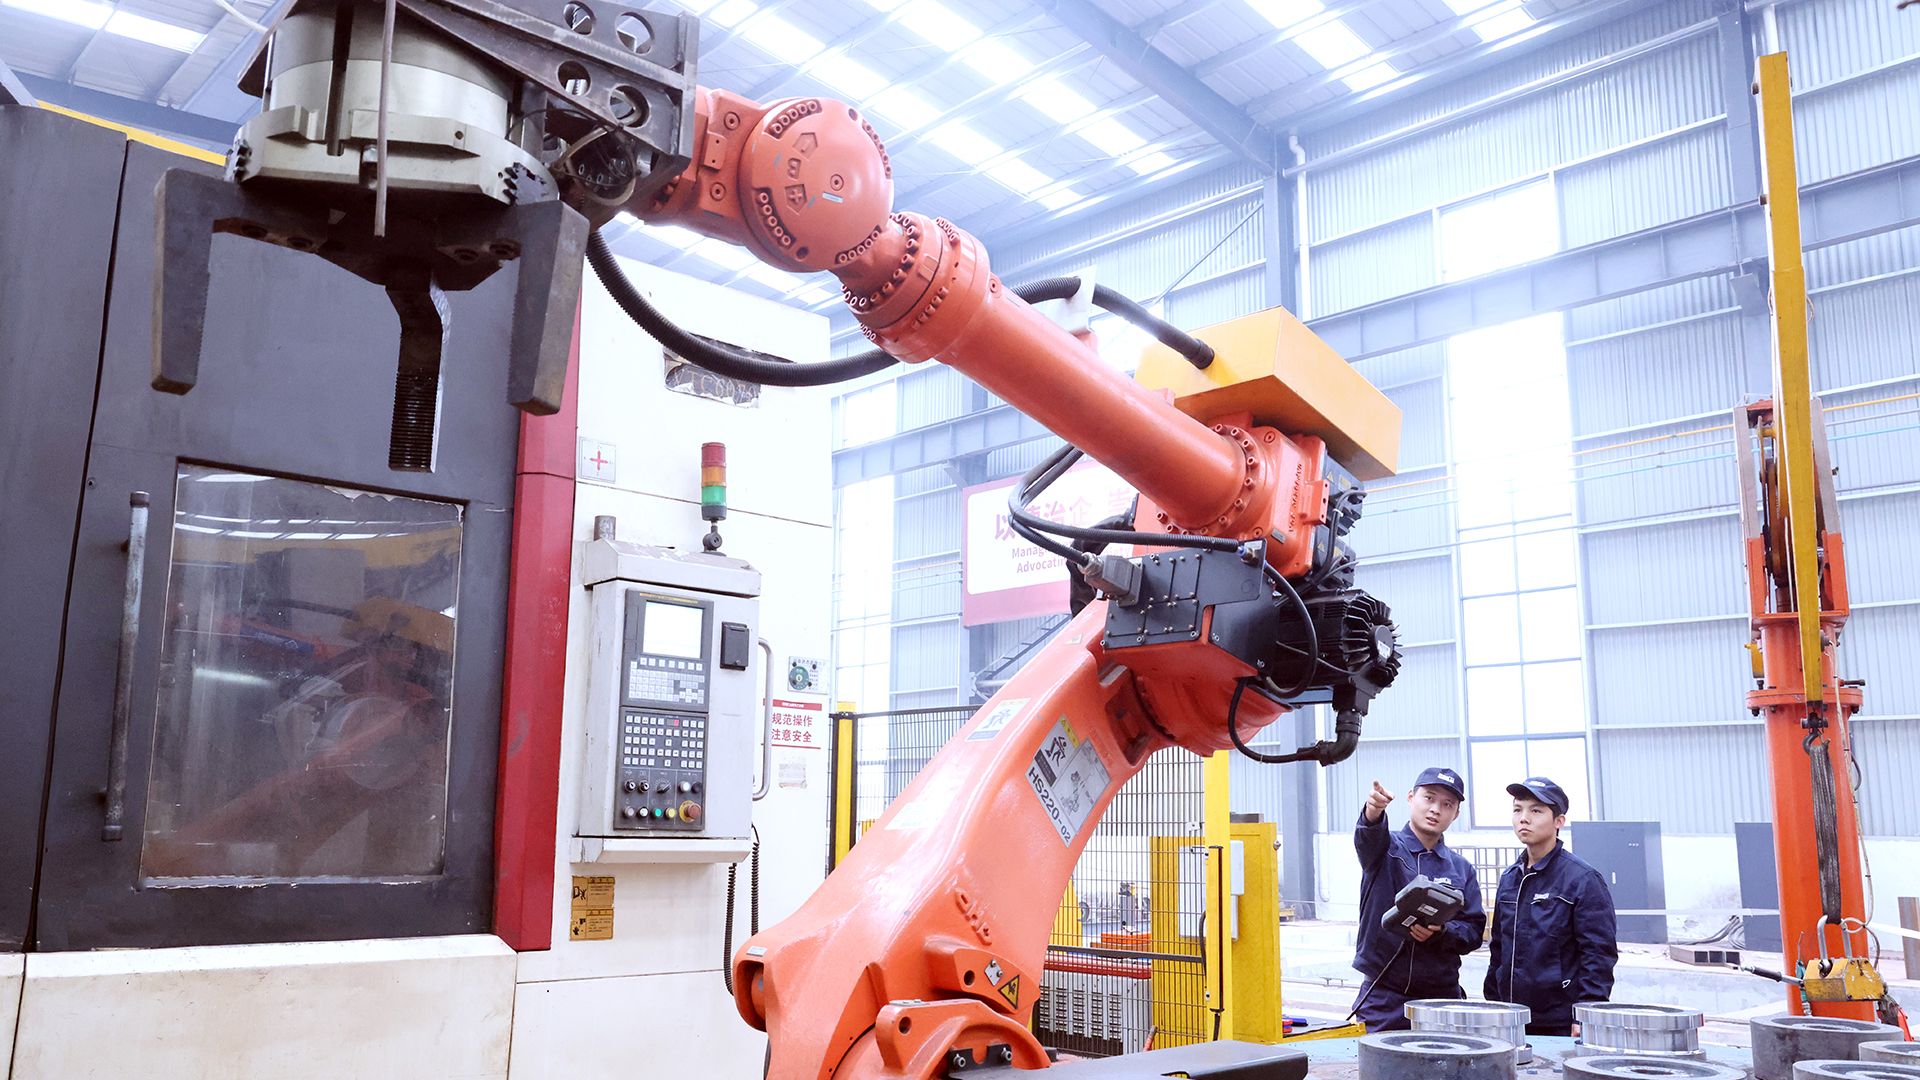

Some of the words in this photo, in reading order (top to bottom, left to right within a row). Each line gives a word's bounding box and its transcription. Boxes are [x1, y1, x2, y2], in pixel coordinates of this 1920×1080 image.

[1016, 558, 1067, 574] Advocatin
[772, 712, 813, 727] 规范操作
[771, 728, 812, 743] 注意安全
[1028, 767, 1071, 843] HS220-02
